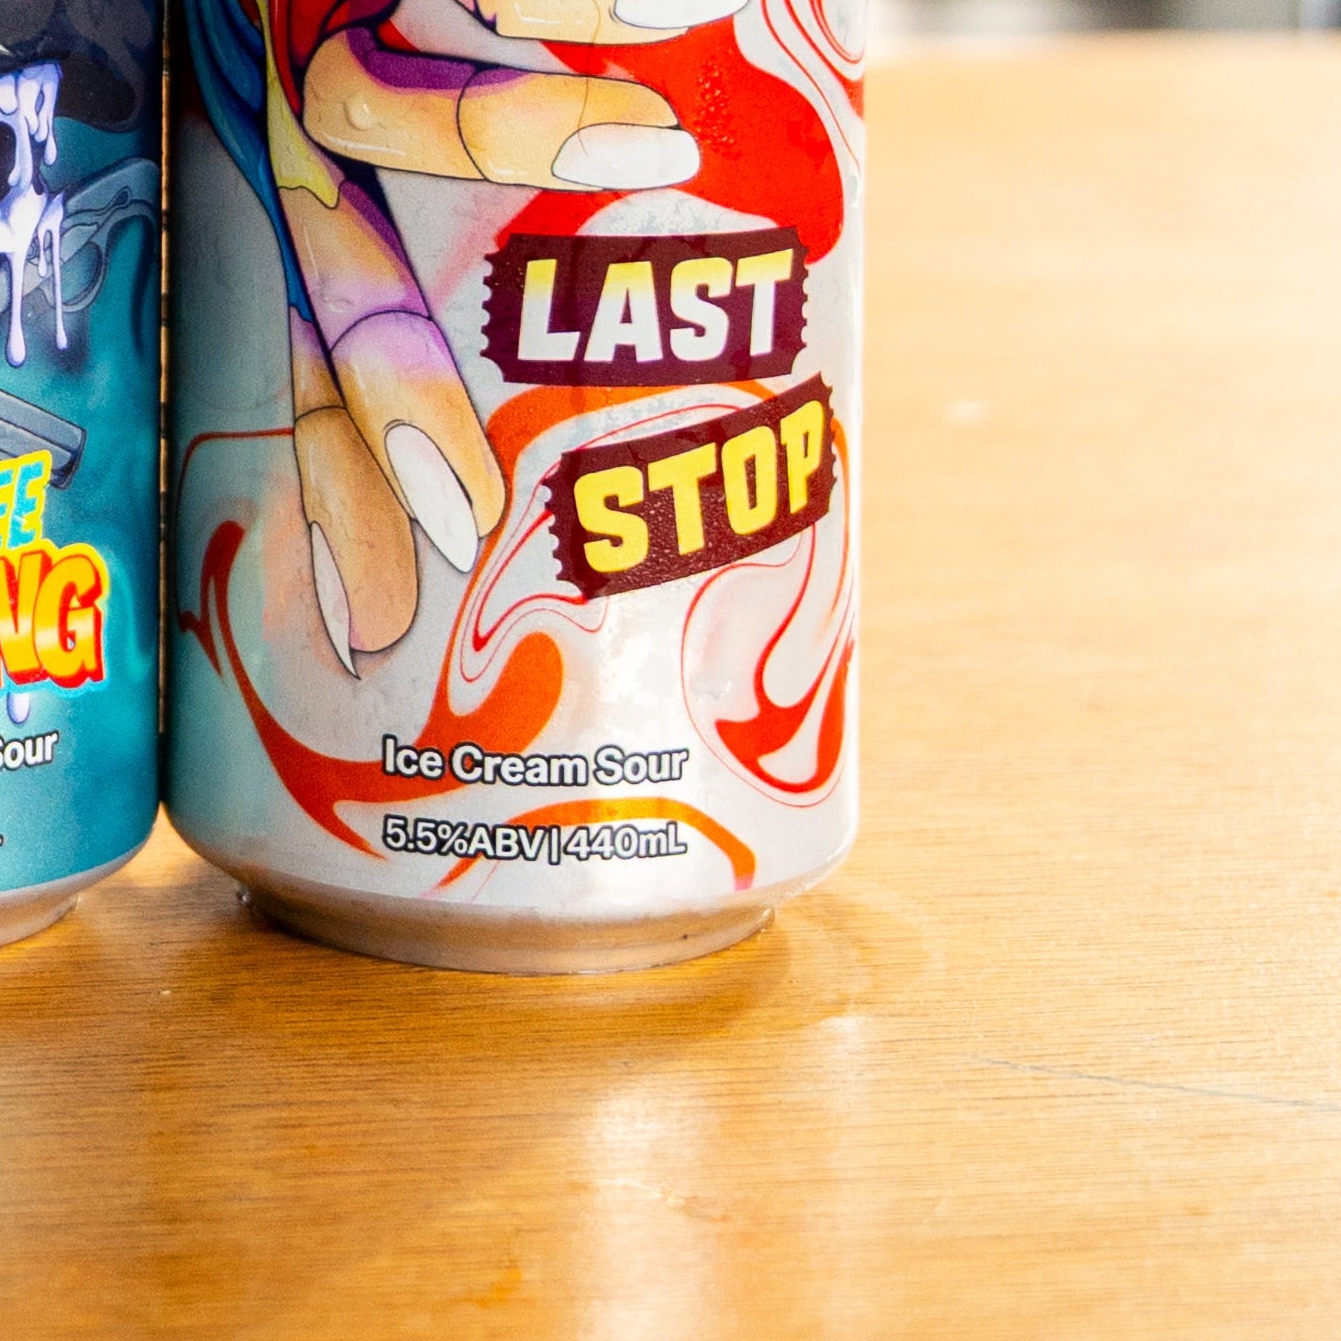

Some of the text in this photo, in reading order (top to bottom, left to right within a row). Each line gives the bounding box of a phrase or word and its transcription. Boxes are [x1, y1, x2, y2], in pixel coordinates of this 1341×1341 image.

[516, 247, 793, 364] LAST
[573, 400, 825, 573] STOP
[382, 734, 689, 786] Ice Cream Sour
